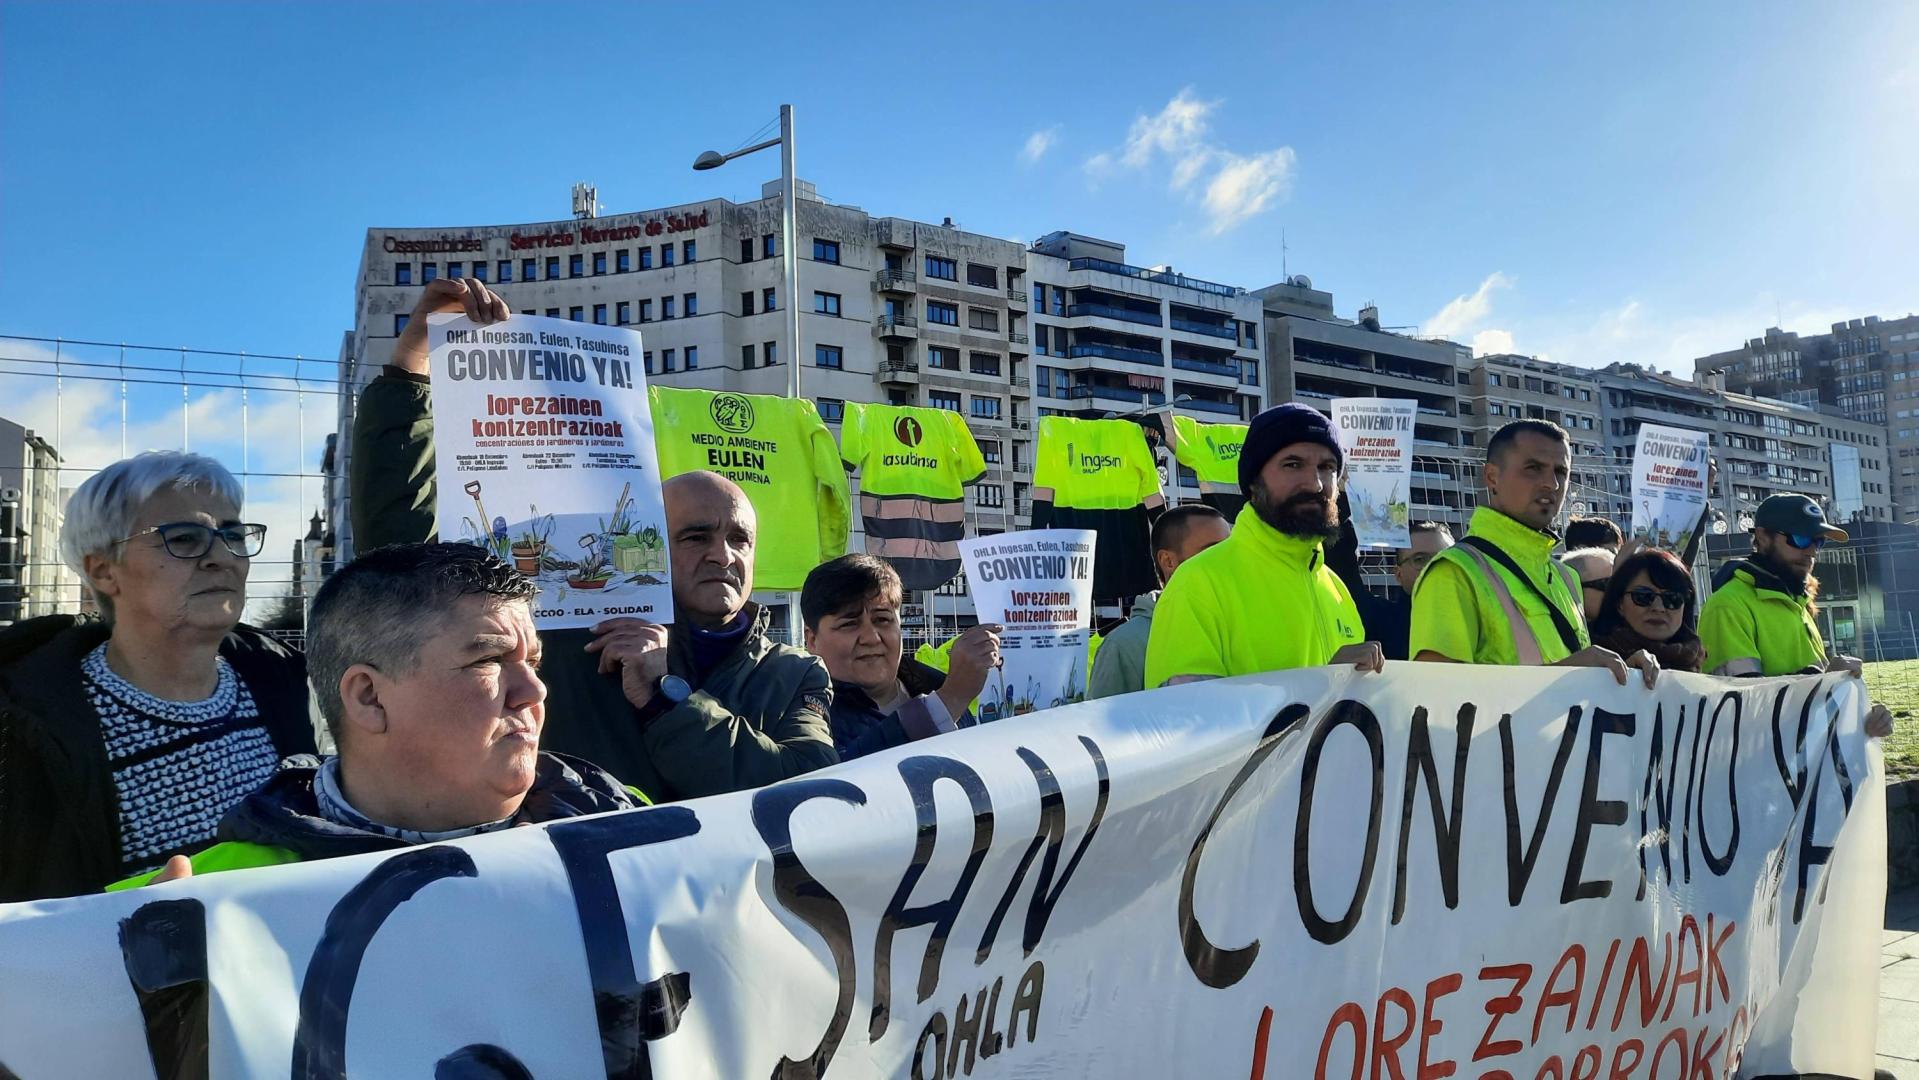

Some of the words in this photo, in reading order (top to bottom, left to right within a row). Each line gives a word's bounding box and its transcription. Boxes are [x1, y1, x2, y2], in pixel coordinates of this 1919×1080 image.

[510, 231, 574, 251] Servicio
[580, 225, 640, 245] Navarro
[645, 220, 663, 237] de
[666, 208, 709, 234] Salud
[446, 329, 479, 344] OHLA
[482, 330, 537, 346] Ingesan,
[540, 331, 574, 350] Eulen,
[575, 336, 630, 357] Tasubinsa
[448, 349, 587, 382] CONVENIO
[592, 356, 633, 389] YA!
[487, 394, 603, 417] lorezainen
[472, 418, 624, 438] kontzentrazioak
[1340, 414, 1394, 431] CONVENIO
[1396, 416, 1411, 431] YA!
[536, 439, 545, 447] de
[691, 433, 725, 447] MEDIO
[727, 436, 777, 453] AMBIENTE
[1217, 442, 1244, 457] Inge
[1356, 436, 1396, 447] lorezainen
[707, 448, 765, 471] EULEN
[1349, 448, 1401, 457] kontzentrazioak
[1642, 440, 1698, 462] CONVENIO
[1700, 448, 1709, 464] Y
[710, 470, 771, 485] URUMENA
[1653, 462, 1698, 479] lorezainen
[973, 546, 998, 559] OHLA
[998, 543, 1037, 555] Ingesan,
[1037, 541, 1060, 553] Eulen,
[977, 555, 1066, 583] CONVENIO
[1070, 556, 1089, 580] YA!
[1011, 589, 1071, 607] lorezainen
[534, 609, 565, 618] CCOO
[574, 607, 595, 616] ELA
[603, 605, 654, 615] SOLIDARI
[1004, 607, 1078, 623] kontzentrazioak
[0, 735, 1110, 1080] GESAN
[1178, 688, 1742, 989] CONVENIO
[1250, 912, 1737, 1080] LOREZAINAK
[911, 960, 1045, 1080] OHLA
